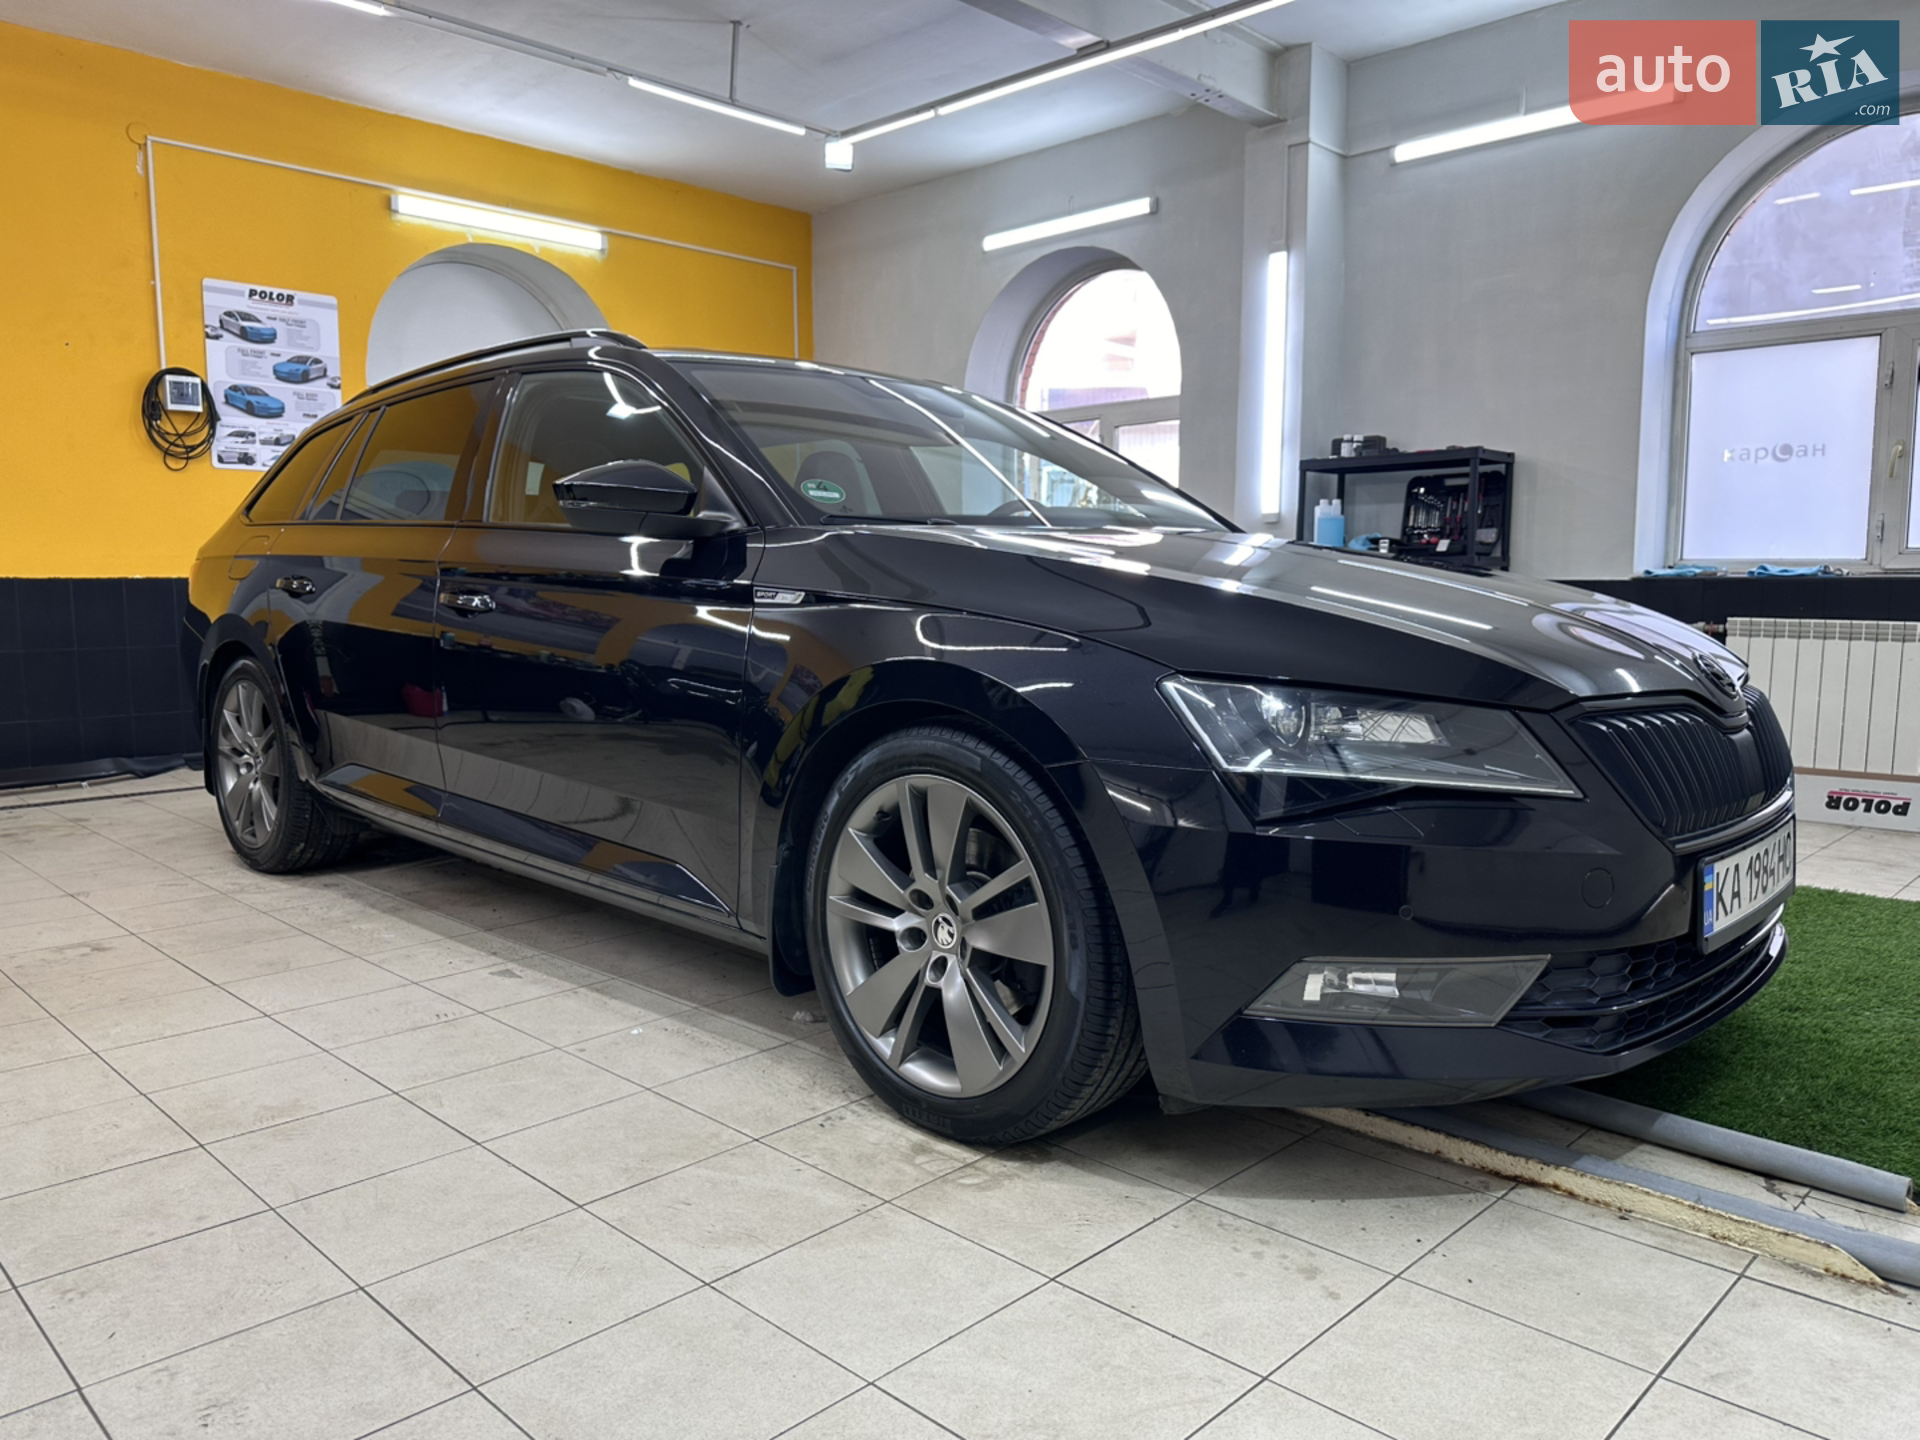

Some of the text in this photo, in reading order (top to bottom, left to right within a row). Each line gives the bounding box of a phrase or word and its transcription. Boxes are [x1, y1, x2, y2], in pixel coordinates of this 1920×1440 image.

[248, 288, 295, 306] POLOR
[1825, 795, 1911, 817] POLOR
[1715, 863, 1742, 921] KA
[1745, 842, 1777, 904] 1984
